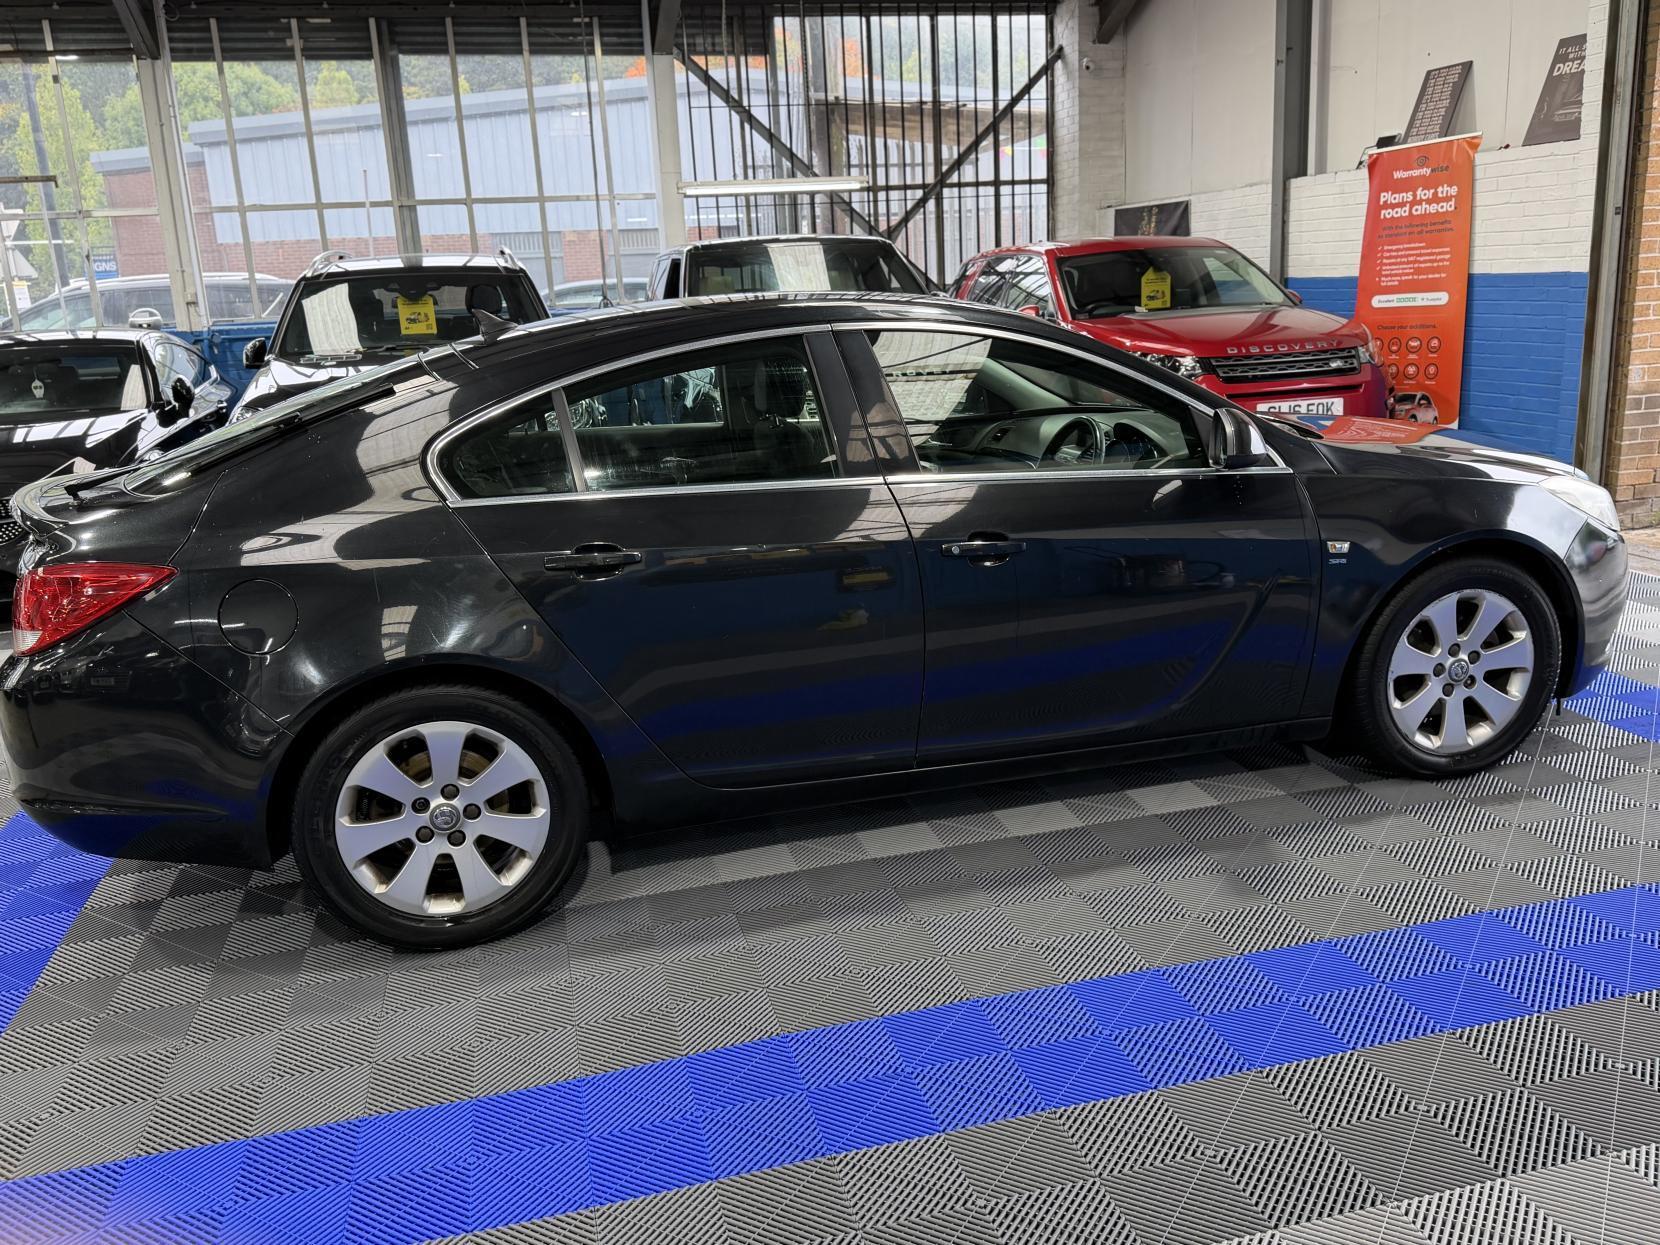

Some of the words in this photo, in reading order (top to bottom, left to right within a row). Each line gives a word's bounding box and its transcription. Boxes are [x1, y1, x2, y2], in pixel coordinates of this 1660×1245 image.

[1379, 190, 1413, 205] Plans
[1416, 187, 1435, 201] for
[1437, 183, 1458, 198] the
[1380, 203, 1410, 219] road
[1226, 340, 1338, 354] DISCOVERY
